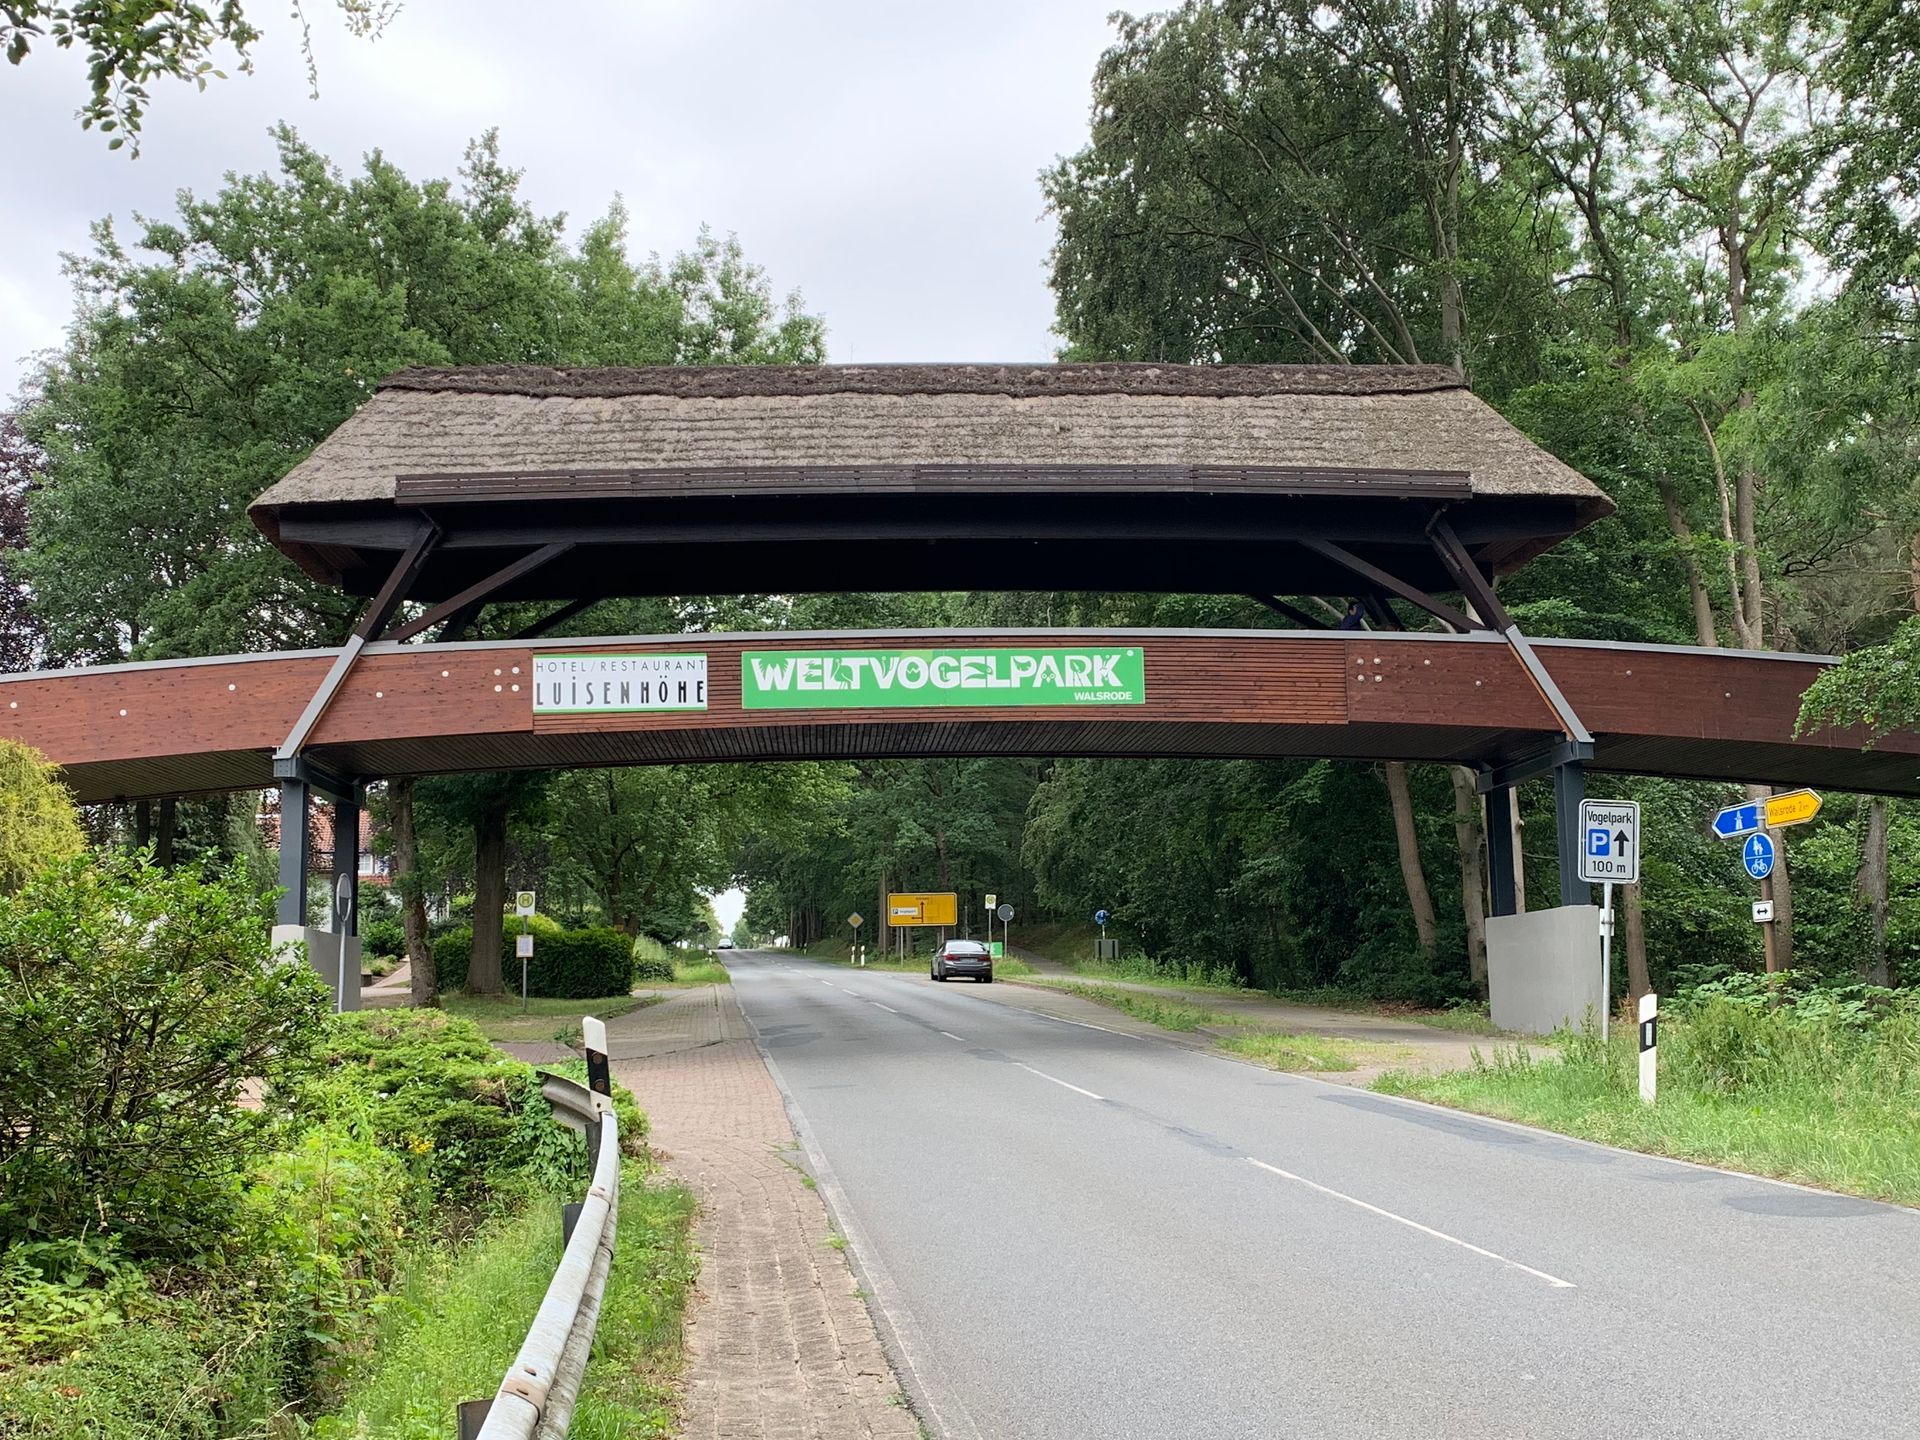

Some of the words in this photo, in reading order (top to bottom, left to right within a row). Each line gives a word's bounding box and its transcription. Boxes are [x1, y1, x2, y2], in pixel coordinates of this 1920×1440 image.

[536, 659, 705, 673] HOTEL/RESTAURANT
[1074, 691, 1133, 701] WALSRODE
[1587, 810, 1632, 826] Vogelpark
[1591, 832, 1608, 853] P
[1592, 860, 1613, 873] 100
[1616, 864, 1626, 873] m
